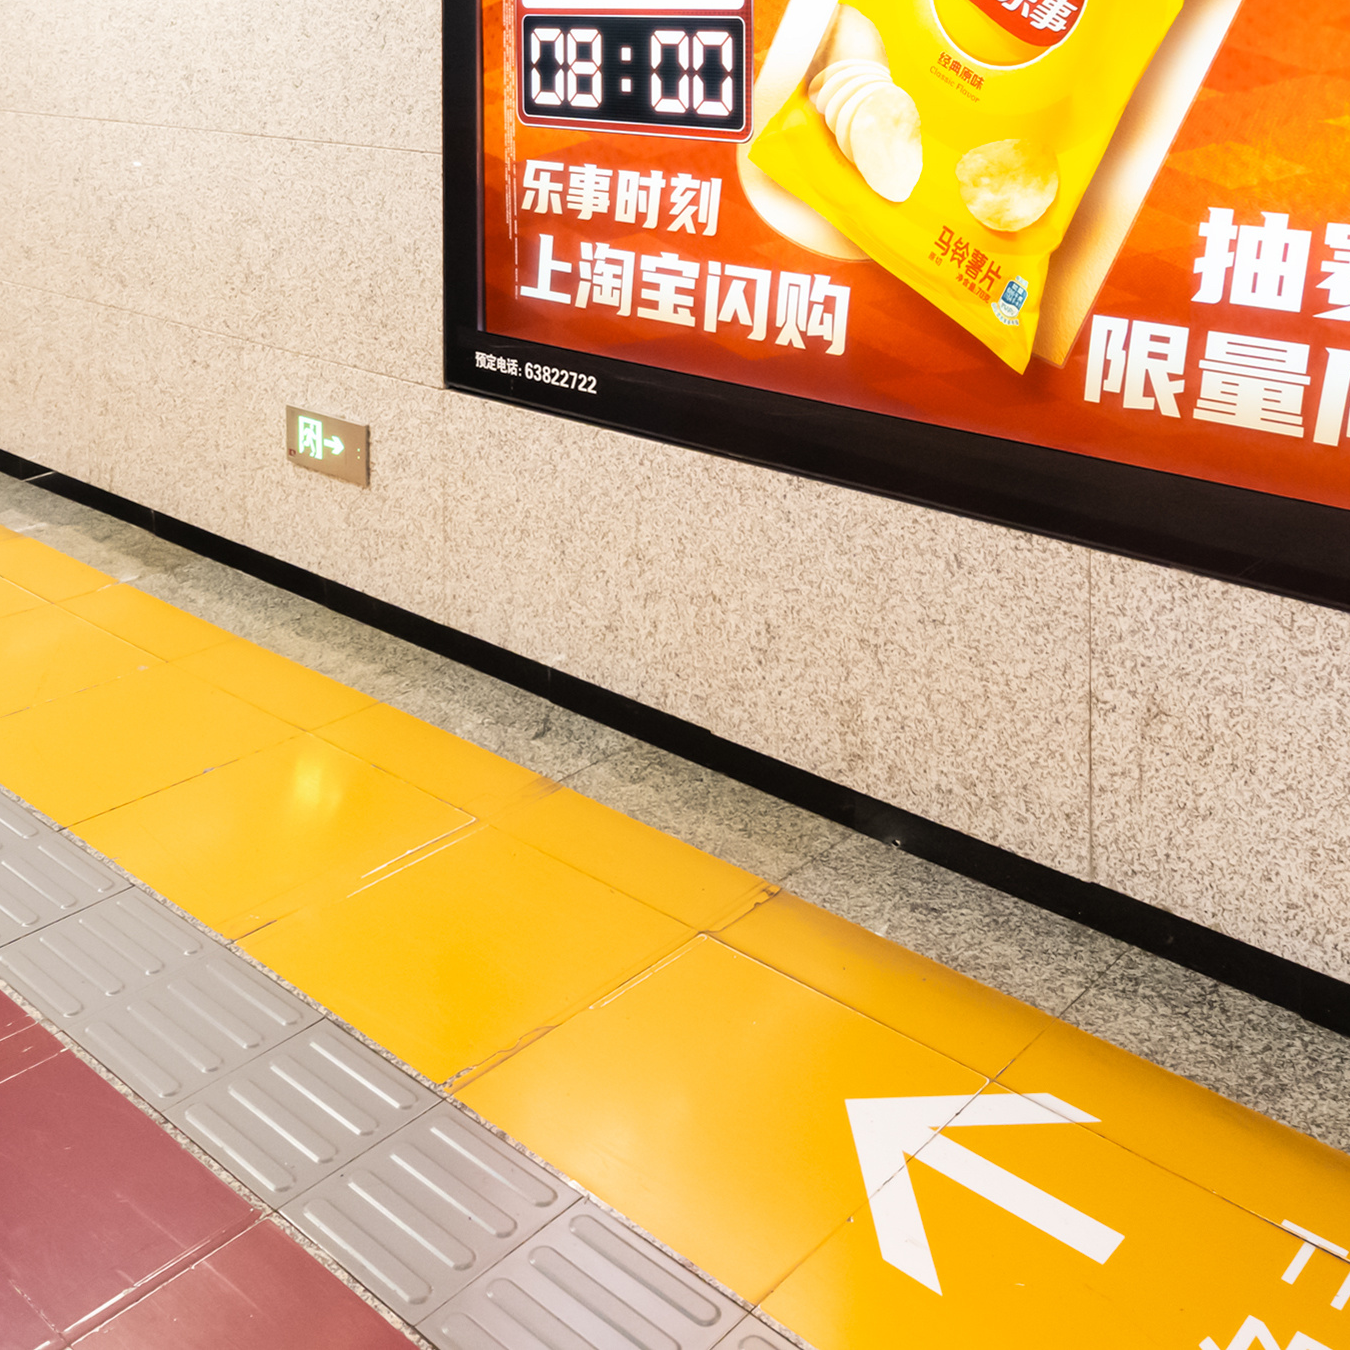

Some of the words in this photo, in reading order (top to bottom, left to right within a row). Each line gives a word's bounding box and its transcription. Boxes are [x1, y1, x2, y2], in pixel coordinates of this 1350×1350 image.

[531, 28, 733, 116] 08:00
[930, 66, 955, 88] Classic
[956, 83, 980, 103] Flavor
[937, 51, 985, 90] 经典原味
[521, 159, 722, 237] 乐事时刻
[934, 225, 1002, 291] 马铃薯片
[520, 234, 850, 356] 上淘宝闪购
[524, 362, 597, 394] 63822722
